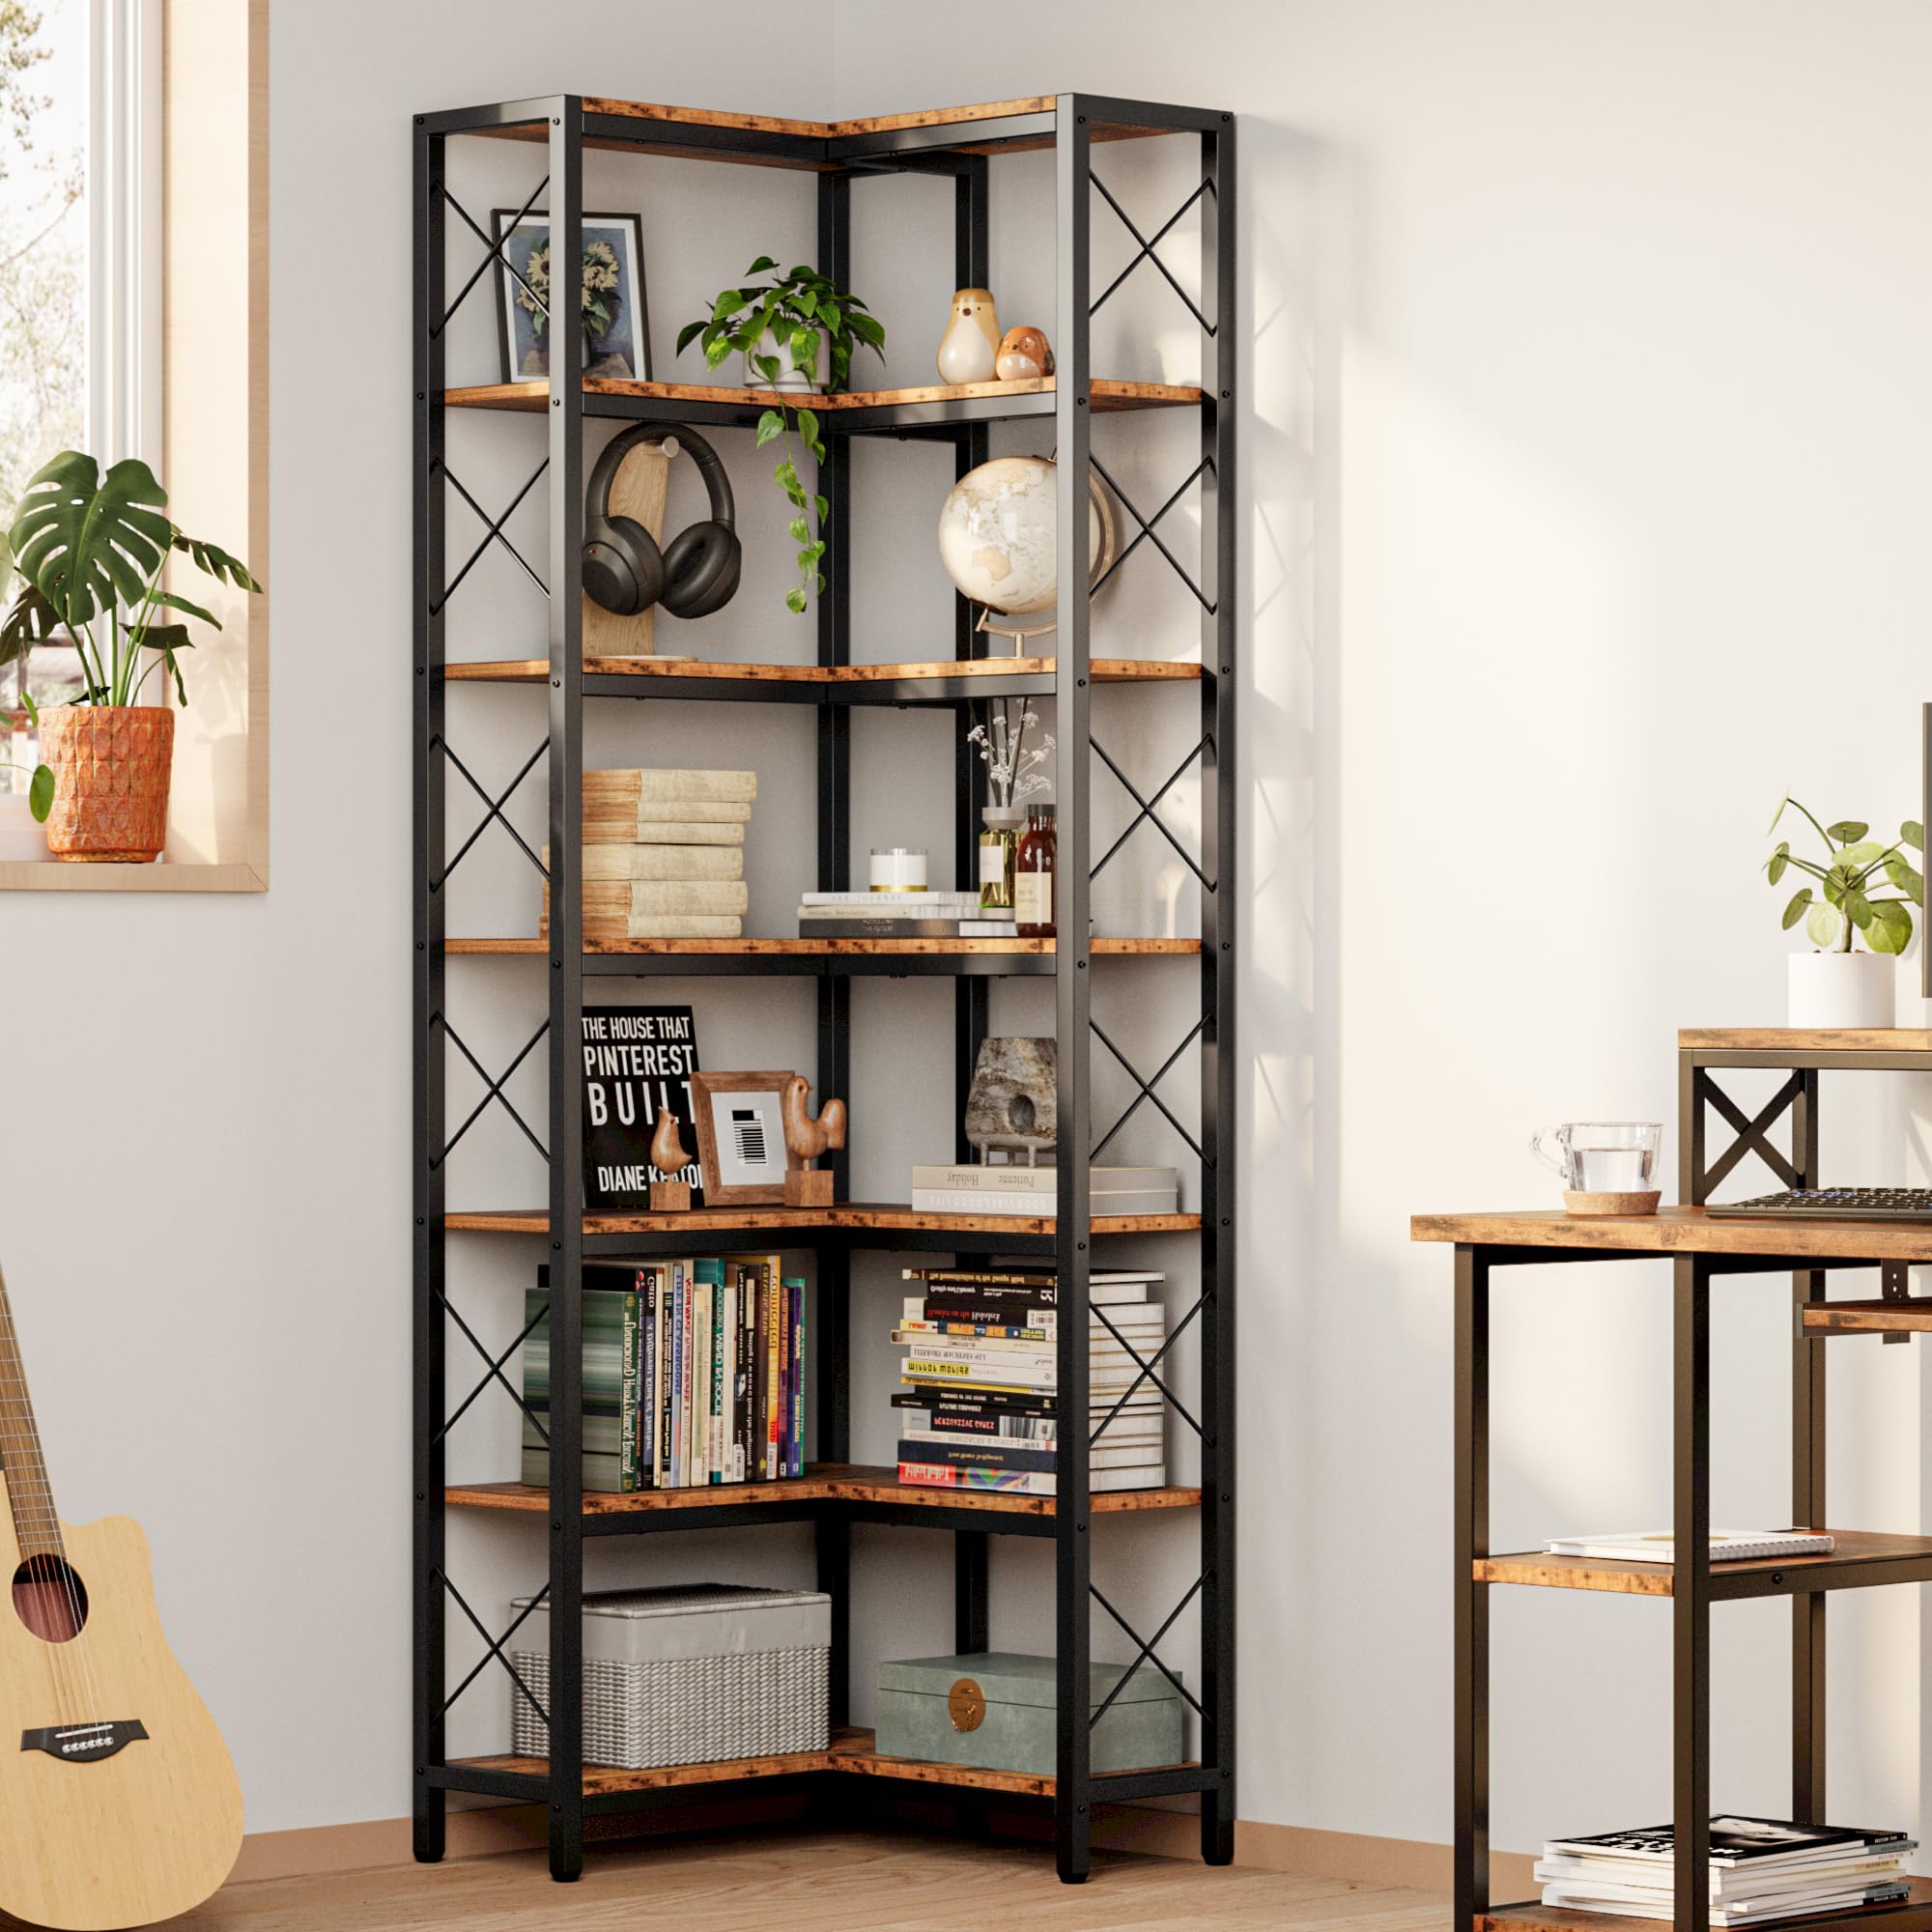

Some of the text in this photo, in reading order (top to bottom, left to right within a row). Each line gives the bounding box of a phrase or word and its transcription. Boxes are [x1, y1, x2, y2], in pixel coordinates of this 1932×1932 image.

[582, 1015, 690, 1040] THE HOUSE THAT
[582, 1044, 694, 1076] PINTEREST
[597, 1165, 647, 1192] DIANE
[947, 1171, 980, 1188] Holiday
